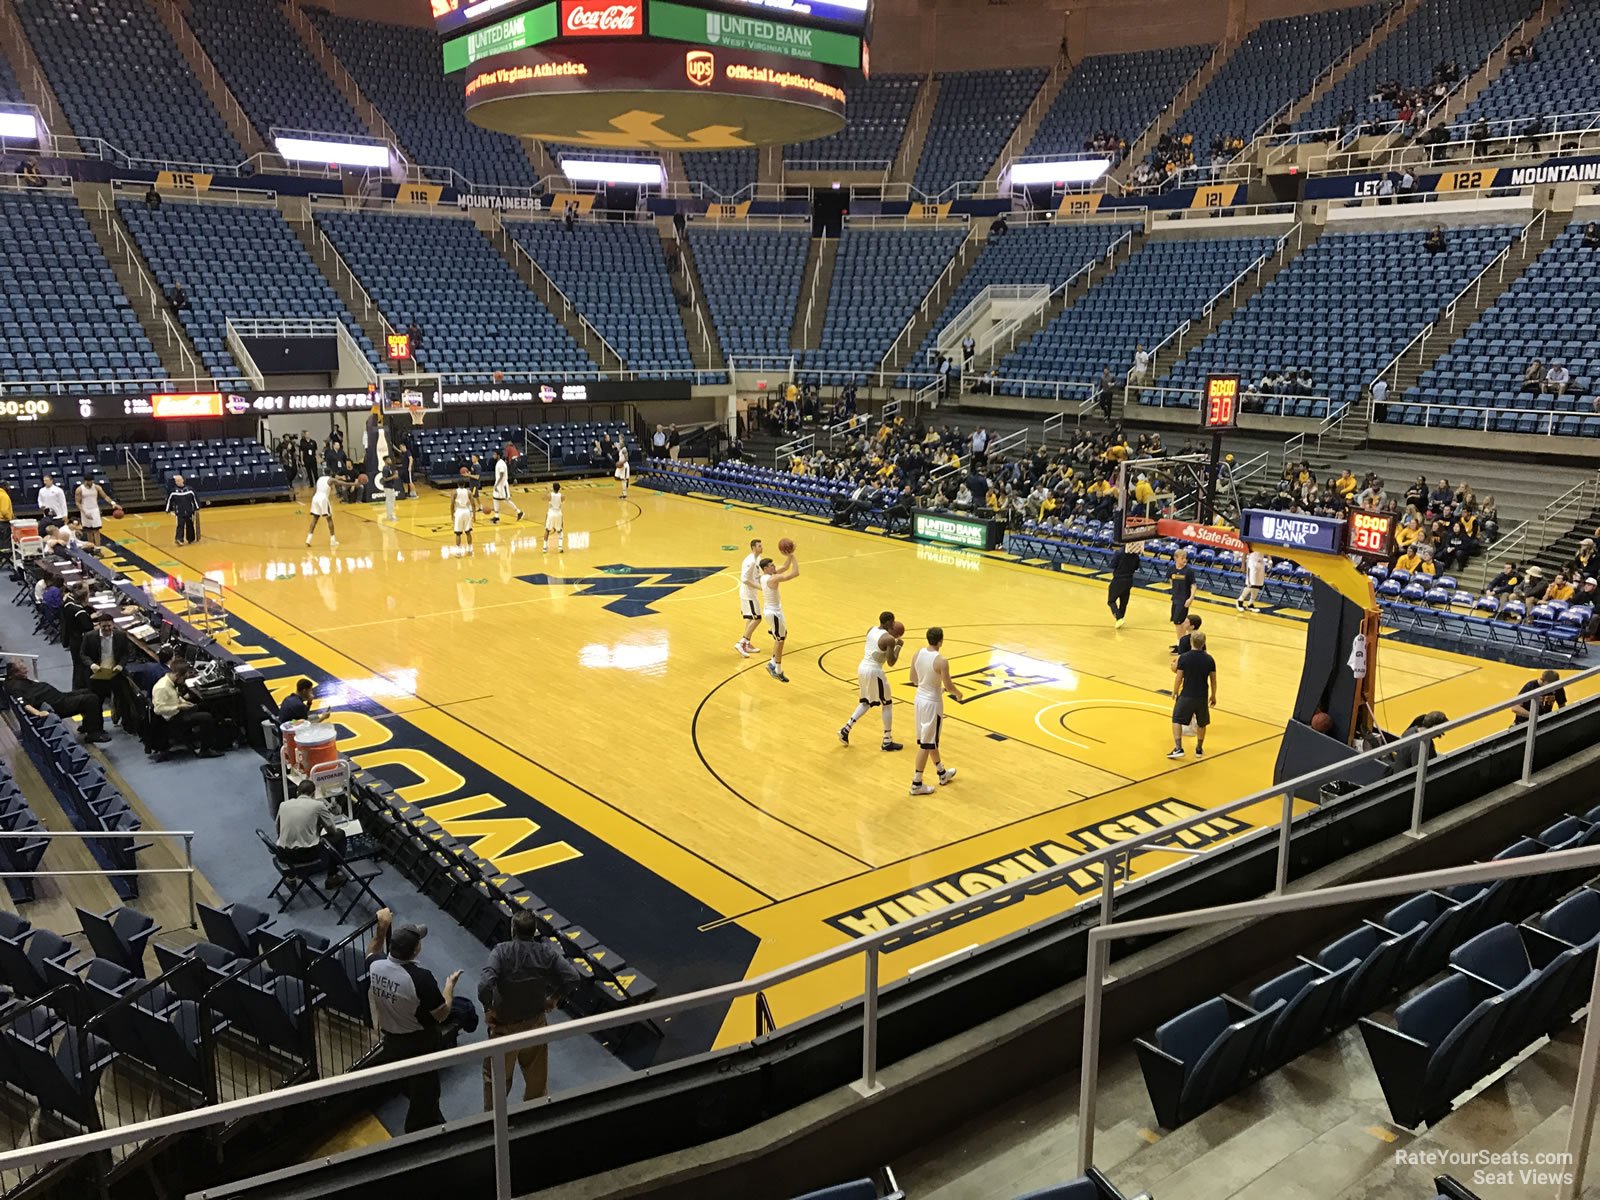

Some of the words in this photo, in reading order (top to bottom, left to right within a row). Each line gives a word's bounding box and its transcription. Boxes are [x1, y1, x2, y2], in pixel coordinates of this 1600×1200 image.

[567, 5, 637, 30] Coca-Cola
[475, 25, 503, 49] UNITED
[503, 16, 526, 39] BANK
[722, 15, 774, 40] UNITED
[776, 26, 813, 46] BANK
[722, 36, 746, 47] WEST
[791, 48, 812, 58] BANK
[480, 71, 497, 86] West
[497, 65, 533, 83] Virginia
[533, 61, 588, 77] Athletics.
[689, 62, 712, 80] ups
[726, 64, 768, 81] Official
[768, 69, 809, 88] Logistics
[172, 174, 194, 188] 115
[1453, 172, 1482, 190] 122
[1511, 163, 1600, 185] MOUNTAIN
[410, 191, 428, 205] 116
[457, 194, 542, 211] MOUNTAINEERS
[1206, 192, 1223, 207] 121
[1070, 201, 1090, 214] 120
[390, 344, 407, 357] 30
[1210, 379, 1236, 397] 60:00
[289, 394, 332, 409] HIGH
[1210, 398, 1232, 422] 30
[925, 518, 956, 533] UNITED
[956, 524, 982, 538] BANK
[1276, 519, 1319, 535] UNITED
[1354, 514, 1388, 532] 60:00
[1196, 528, 1220, 543] State
[1220, 535, 1244, 549] Farm
[1275, 528, 1306, 544] BANK
[1357, 529, 1381, 549] 30
[316, 771, 344, 782] GATORADE
[371, 973, 401, 993] EVENT
[372, 986, 399, 1004] STAFF
